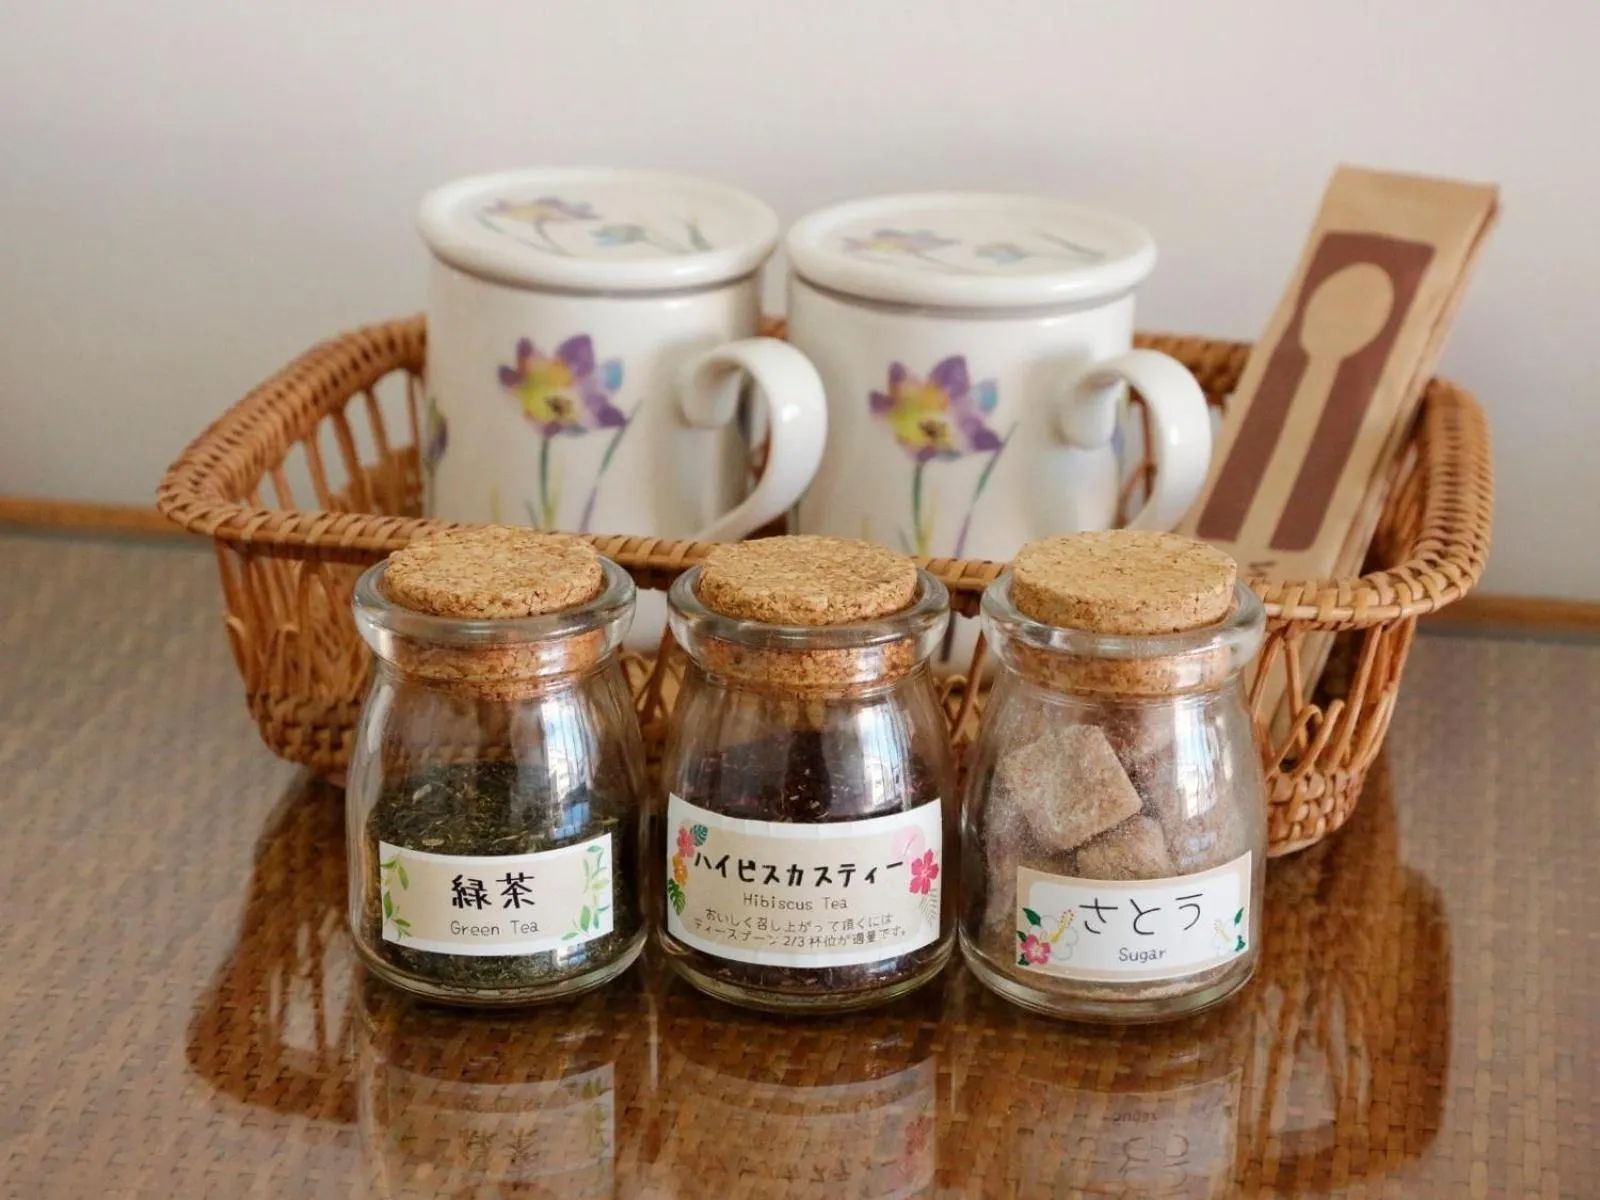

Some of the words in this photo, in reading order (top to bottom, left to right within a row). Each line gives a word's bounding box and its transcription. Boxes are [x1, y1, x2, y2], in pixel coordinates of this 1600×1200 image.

[694, 851, 904, 888] ハイビスカスティー
[450, 871, 536, 910] 緑茶
[742, 893, 813, 911] Hibiscus
[823, 896, 848, 910] Tea
[449, 920, 500, 937] Green
[509, 919, 540, 935] Tea
[1078, 893, 1204, 936] さとう
[1118, 948, 1167, 964] Sugar
